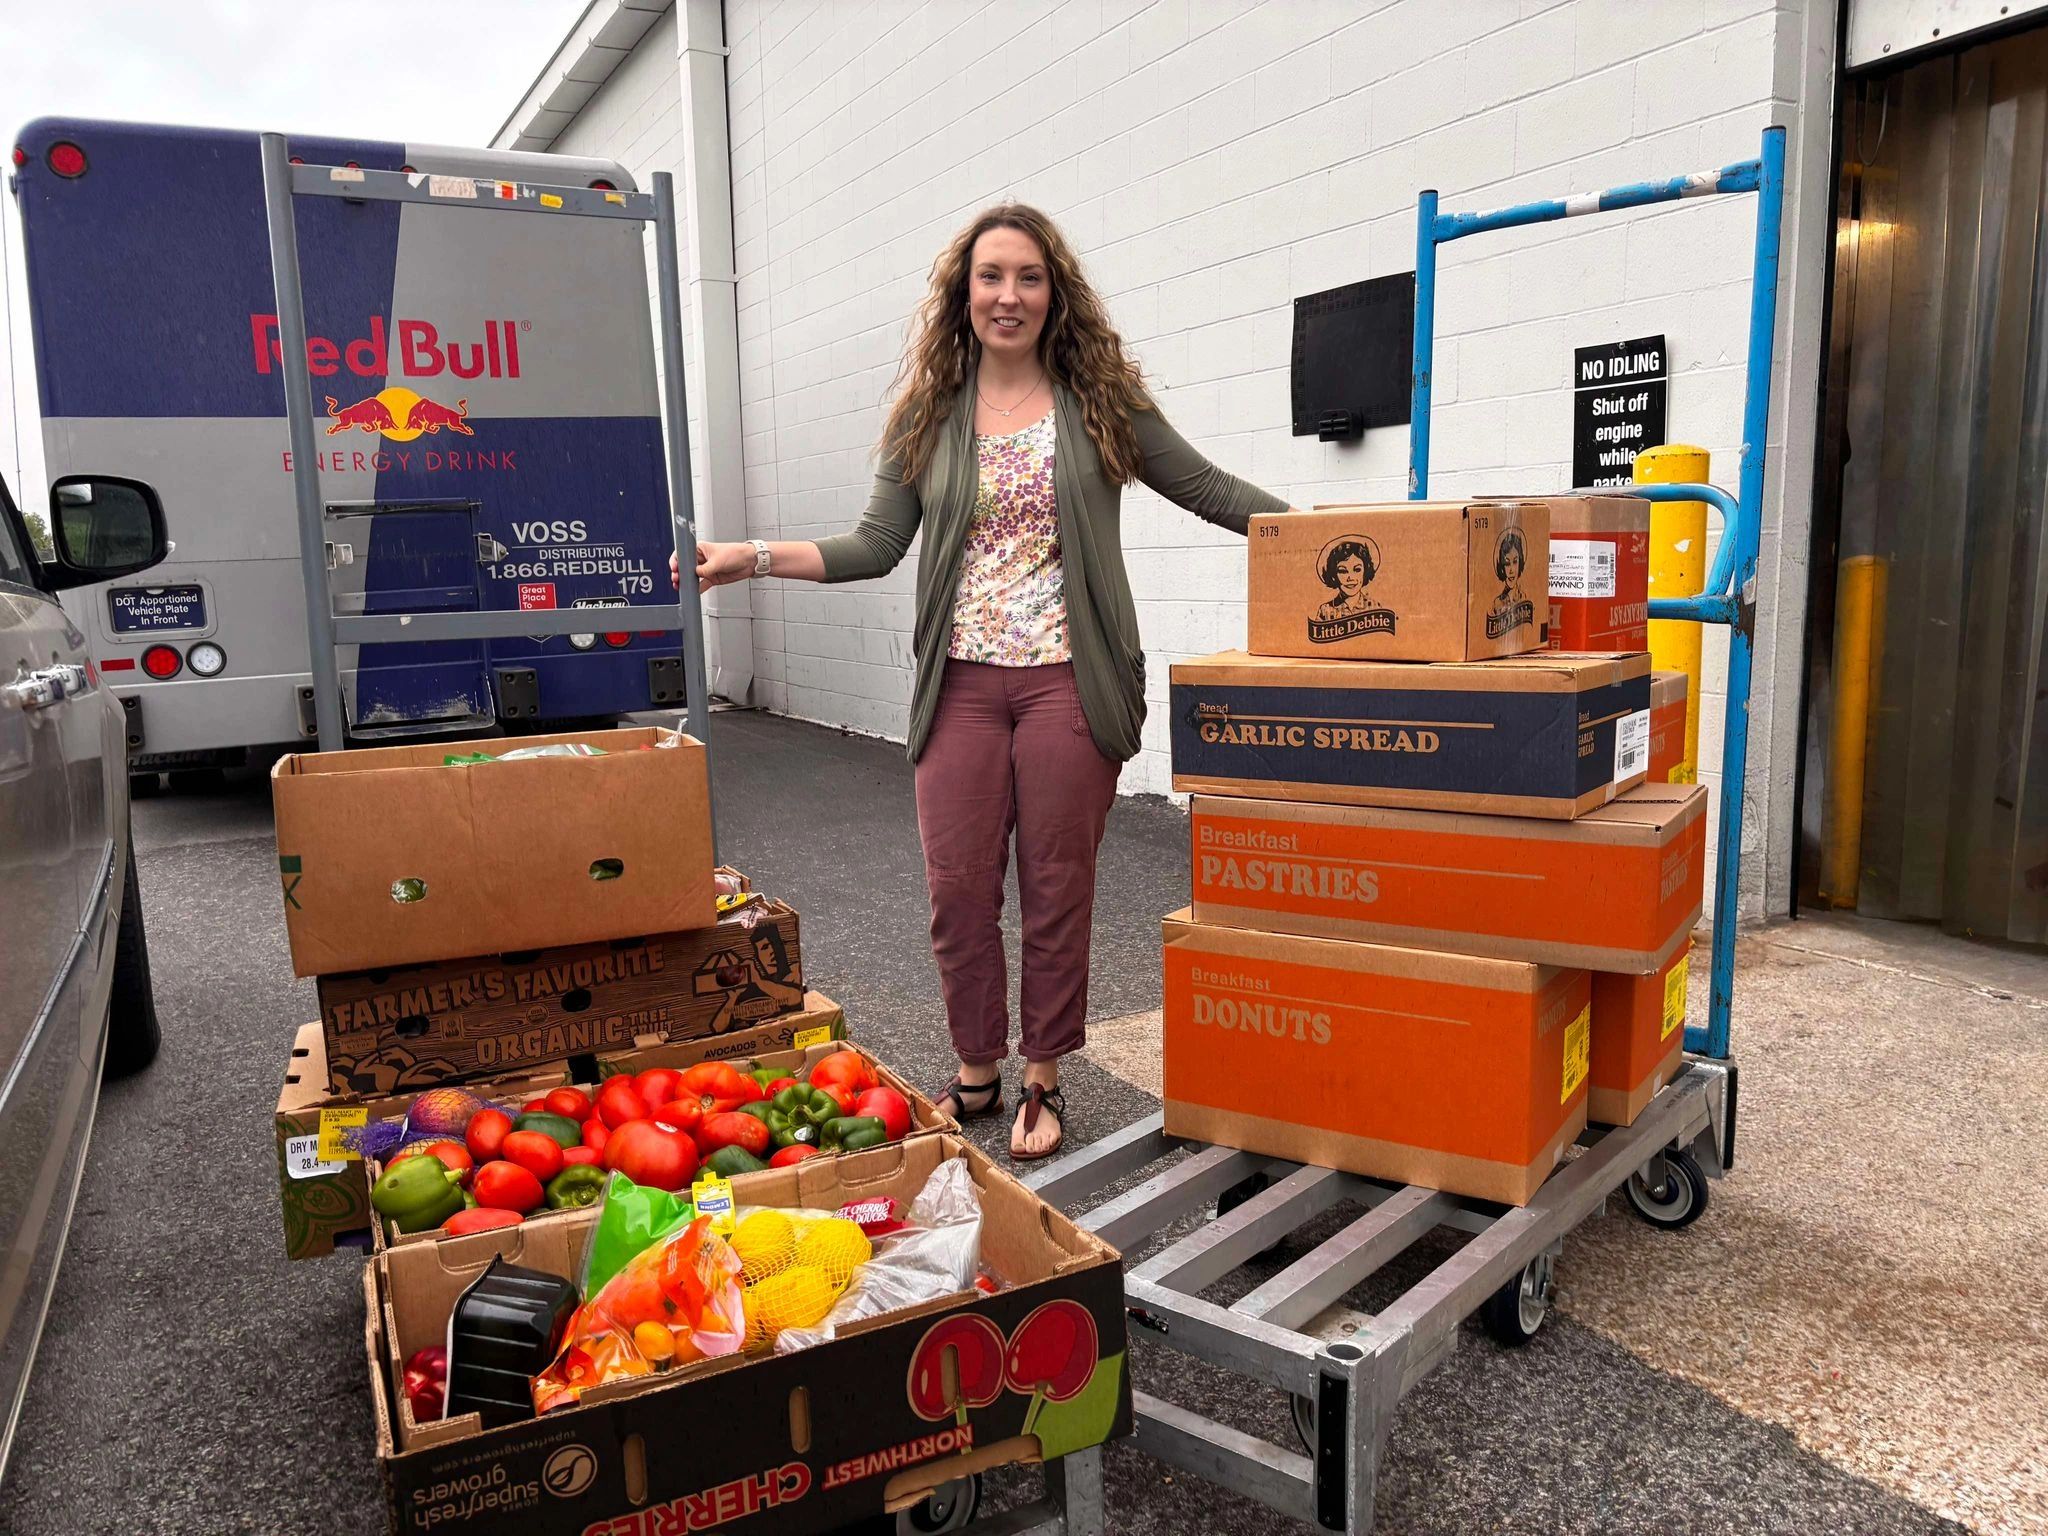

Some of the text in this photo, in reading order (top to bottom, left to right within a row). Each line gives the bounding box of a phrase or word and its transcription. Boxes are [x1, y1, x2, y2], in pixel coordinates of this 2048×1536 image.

[250, 314, 521, 380] Red Bull
[1582, 351, 1660, 381] NO IDLING
[1592, 392, 1649, 416] Shut off
[1595, 421, 1643, 443] engine
[425, 451, 518, 473] DRINK
[1599, 448, 1637, 466] while
[1593, 474, 1633, 488] parke
[511, 520, 588, 544] VOSS
[1259, 525, 1280, 538] 5179
[1473, 517, 1489, 529] 5179
[539, 546, 625, 560] DISTRIBUTING
[487, 559, 652, 579] 1.866.REDBULL
[521, 586, 546, 594] Great
[618, 575, 653, 595] 179
[1548, 581, 1584, 589] CINNAM
[115, 594, 198, 606] DOT Apportioned
[522, 594, 546, 602] Place
[128, 604, 189, 616] Vehicle Plate
[141, 615, 179, 625] In Front
[1311, 615, 1391, 640] Little Debbie
[1199, 702, 1229, 714] Bread
[1200, 721, 1440, 753] GARLIC SPREAD
[1200, 824, 1299, 851] Breakfast
[1201, 855, 1379, 904] PASTRIES
[1191, 966, 1271, 991] Breakfast
[332, 944, 665, 1034] FARMER'S FAVORITE
[629, 1008, 669, 1023] TREE
[1192, 994, 1332, 1045] DONUTS
[628, 1020, 675, 1037] FRUIT
[475, 1015, 624, 1065] ORGANIC
[704, 1040, 757, 1059] AVOCADOS
[290, 1141, 307, 1154] DRY
[822, 1424, 973, 1491] NORTHWEST
[413, 1463, 506, 1505] growers
[415, 1480, 539, 1531] superfresh
